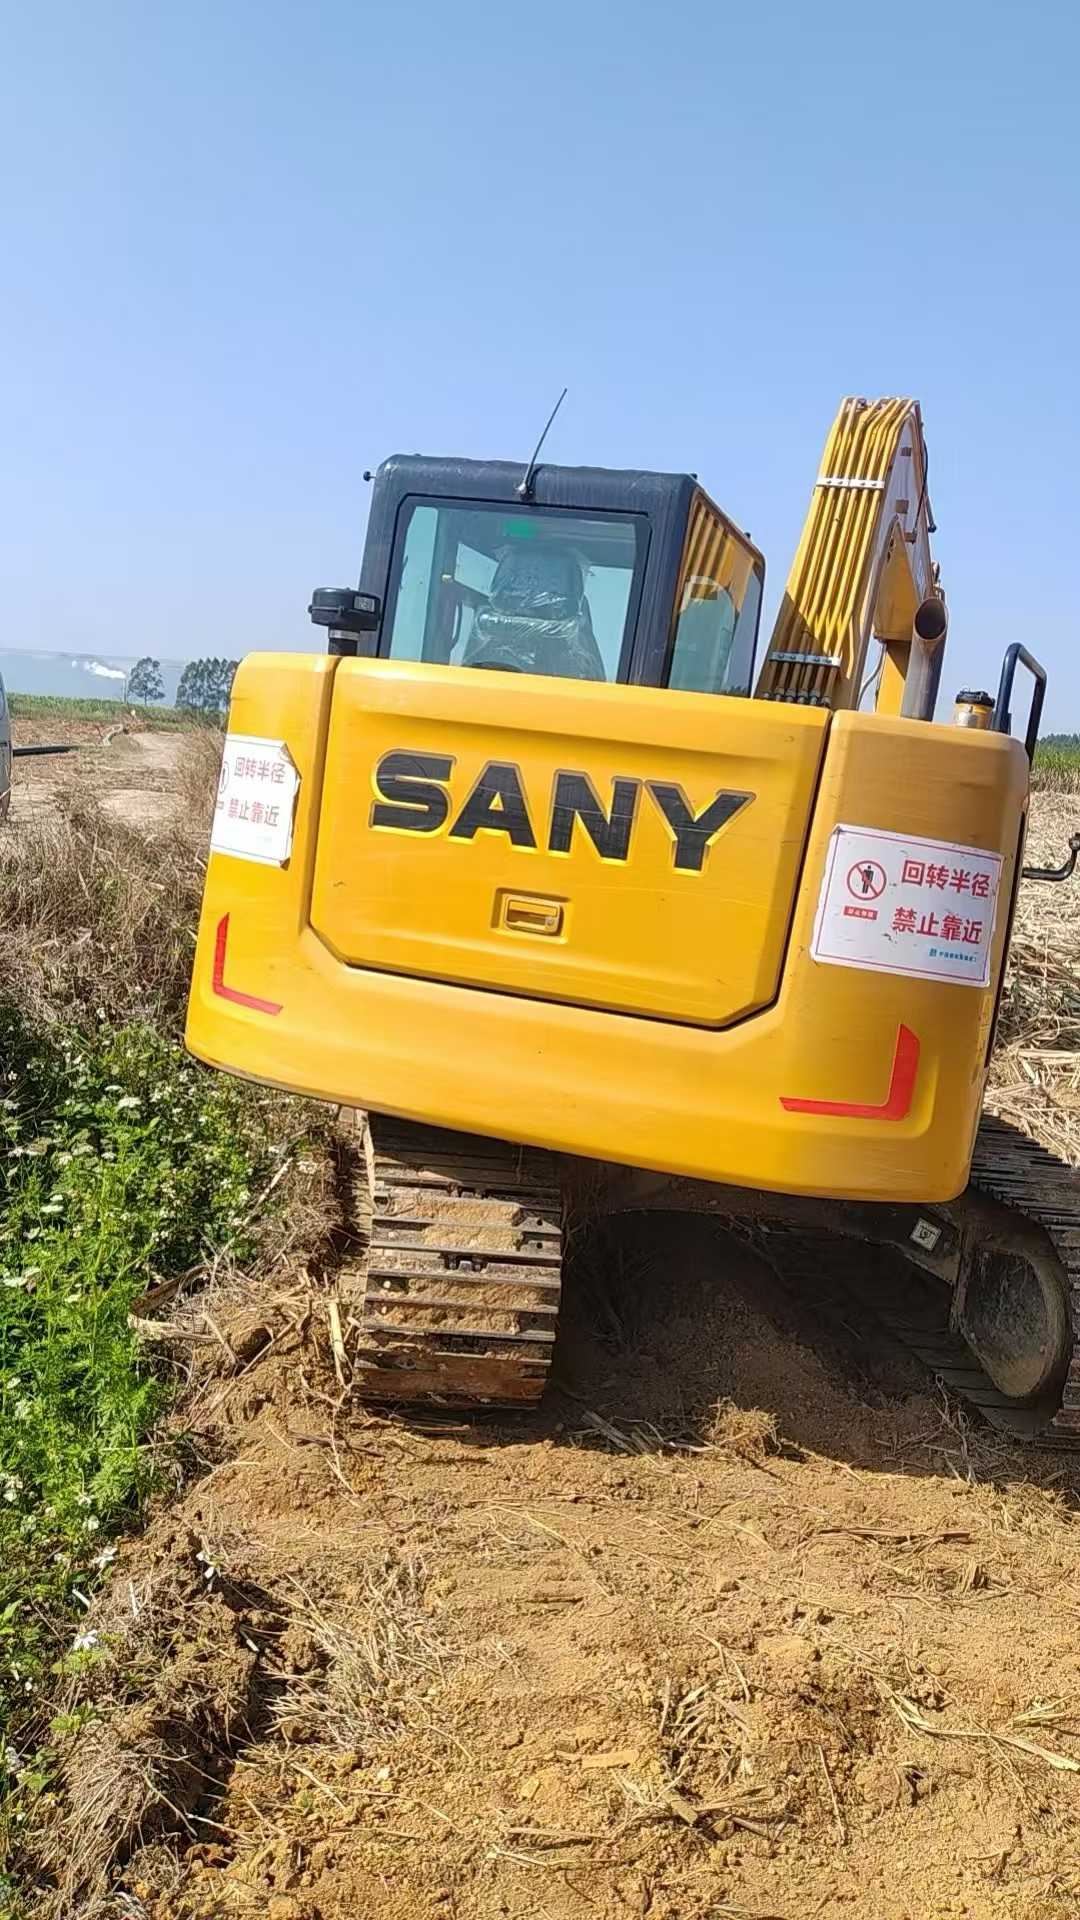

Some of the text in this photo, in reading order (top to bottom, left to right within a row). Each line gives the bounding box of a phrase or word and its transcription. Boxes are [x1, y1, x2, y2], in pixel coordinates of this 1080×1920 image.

[234, 757, 286, 784] 回转半径
[228, 798, 280, 827] 禁止靠近
[370, 749, 755, 875] SANY
[901, 859, 992, 898] 回转半径
[892, 906, 982, 945] 禁止靠近
